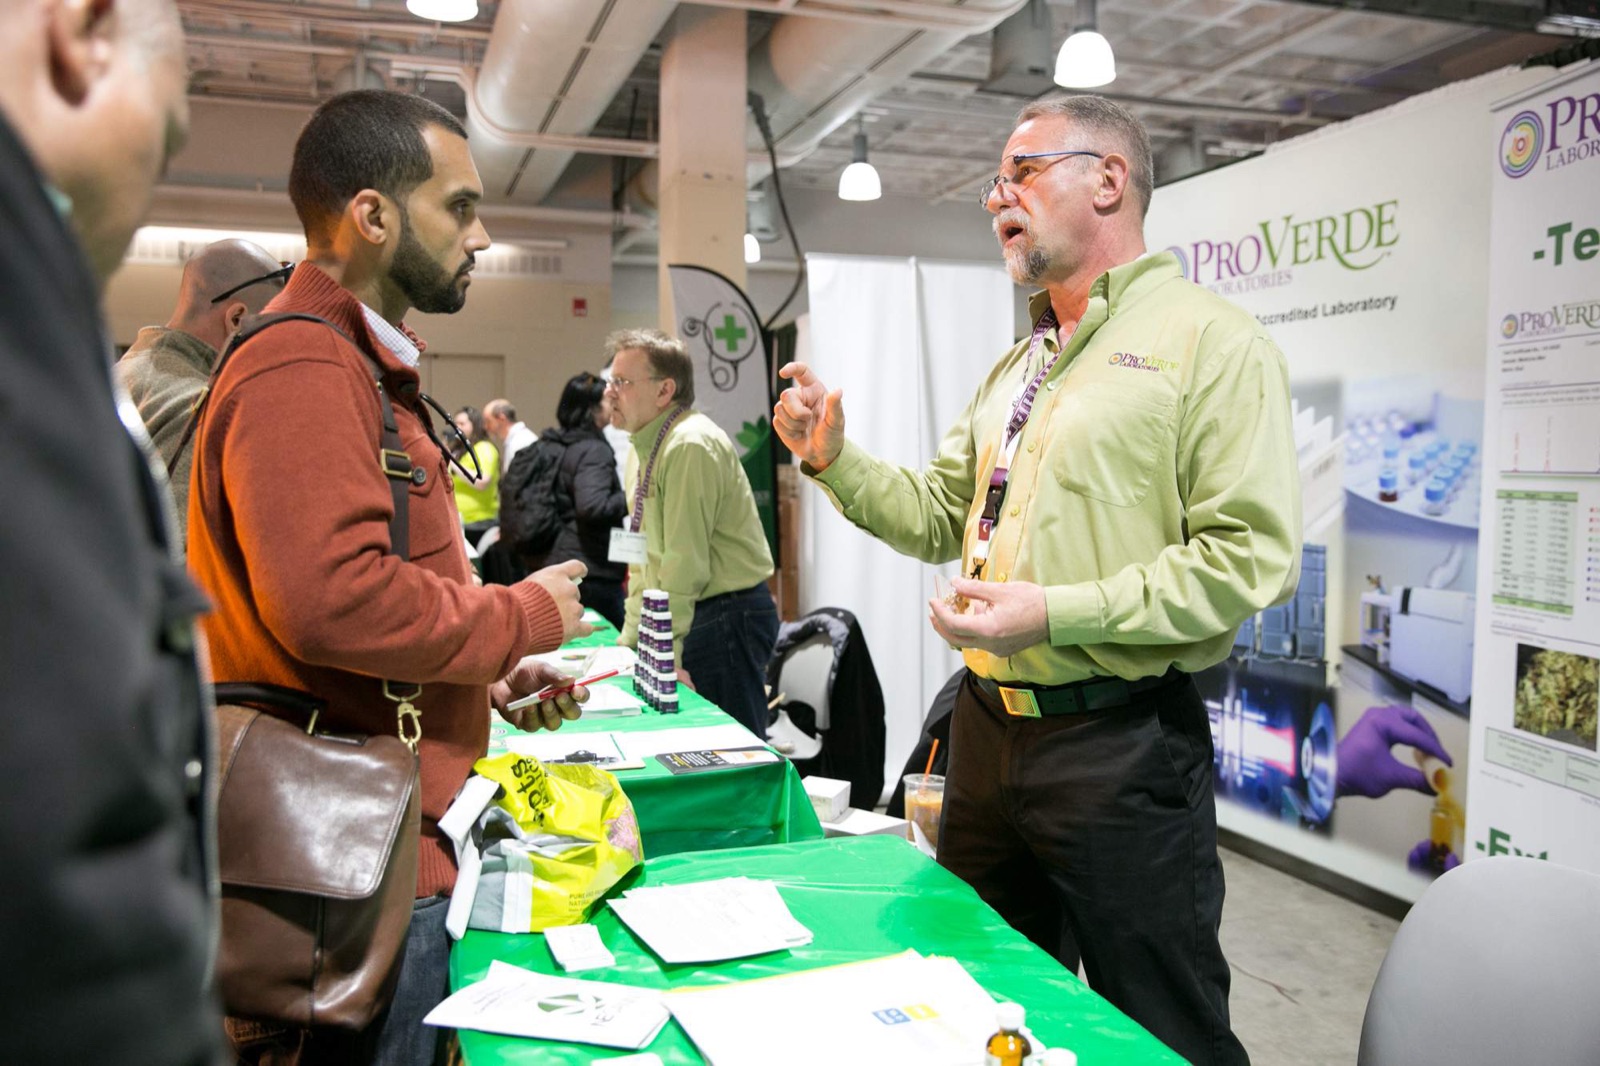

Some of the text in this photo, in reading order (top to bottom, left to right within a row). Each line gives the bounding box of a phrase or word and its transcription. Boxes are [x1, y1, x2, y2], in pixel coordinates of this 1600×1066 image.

[1190, 199, 1399, 284] PROVERDE
[1533, 221, 1600, 266] -Te
[1321, 296, 1398, 317] Laboratory
